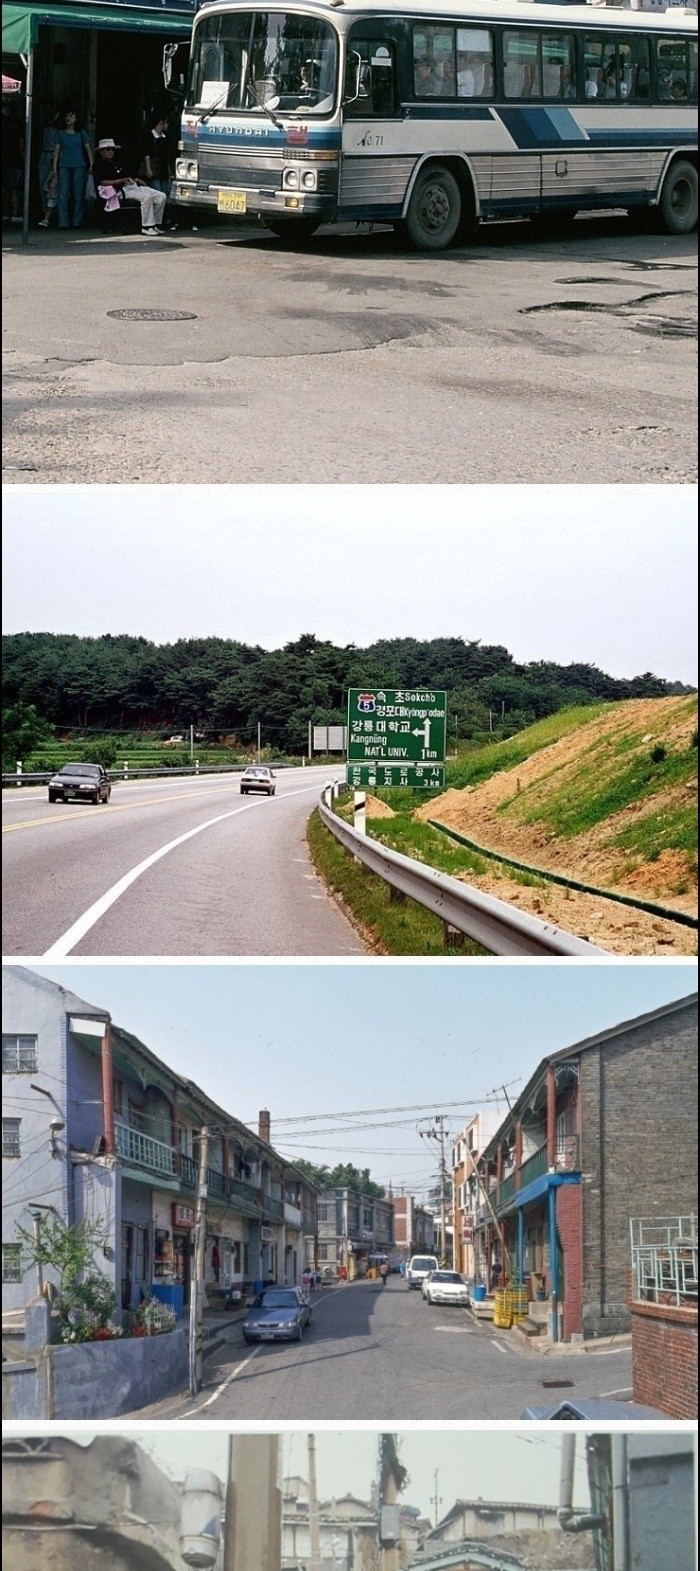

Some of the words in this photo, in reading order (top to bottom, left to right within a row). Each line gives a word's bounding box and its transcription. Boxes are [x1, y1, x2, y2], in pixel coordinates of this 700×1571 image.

[209, 125, 270, 136] HYUNDAI
[363, 701, 370, 711] 5
[376, 705, 405, 717] 경포대
[352, 720, 410, 733] 강릉대학교
